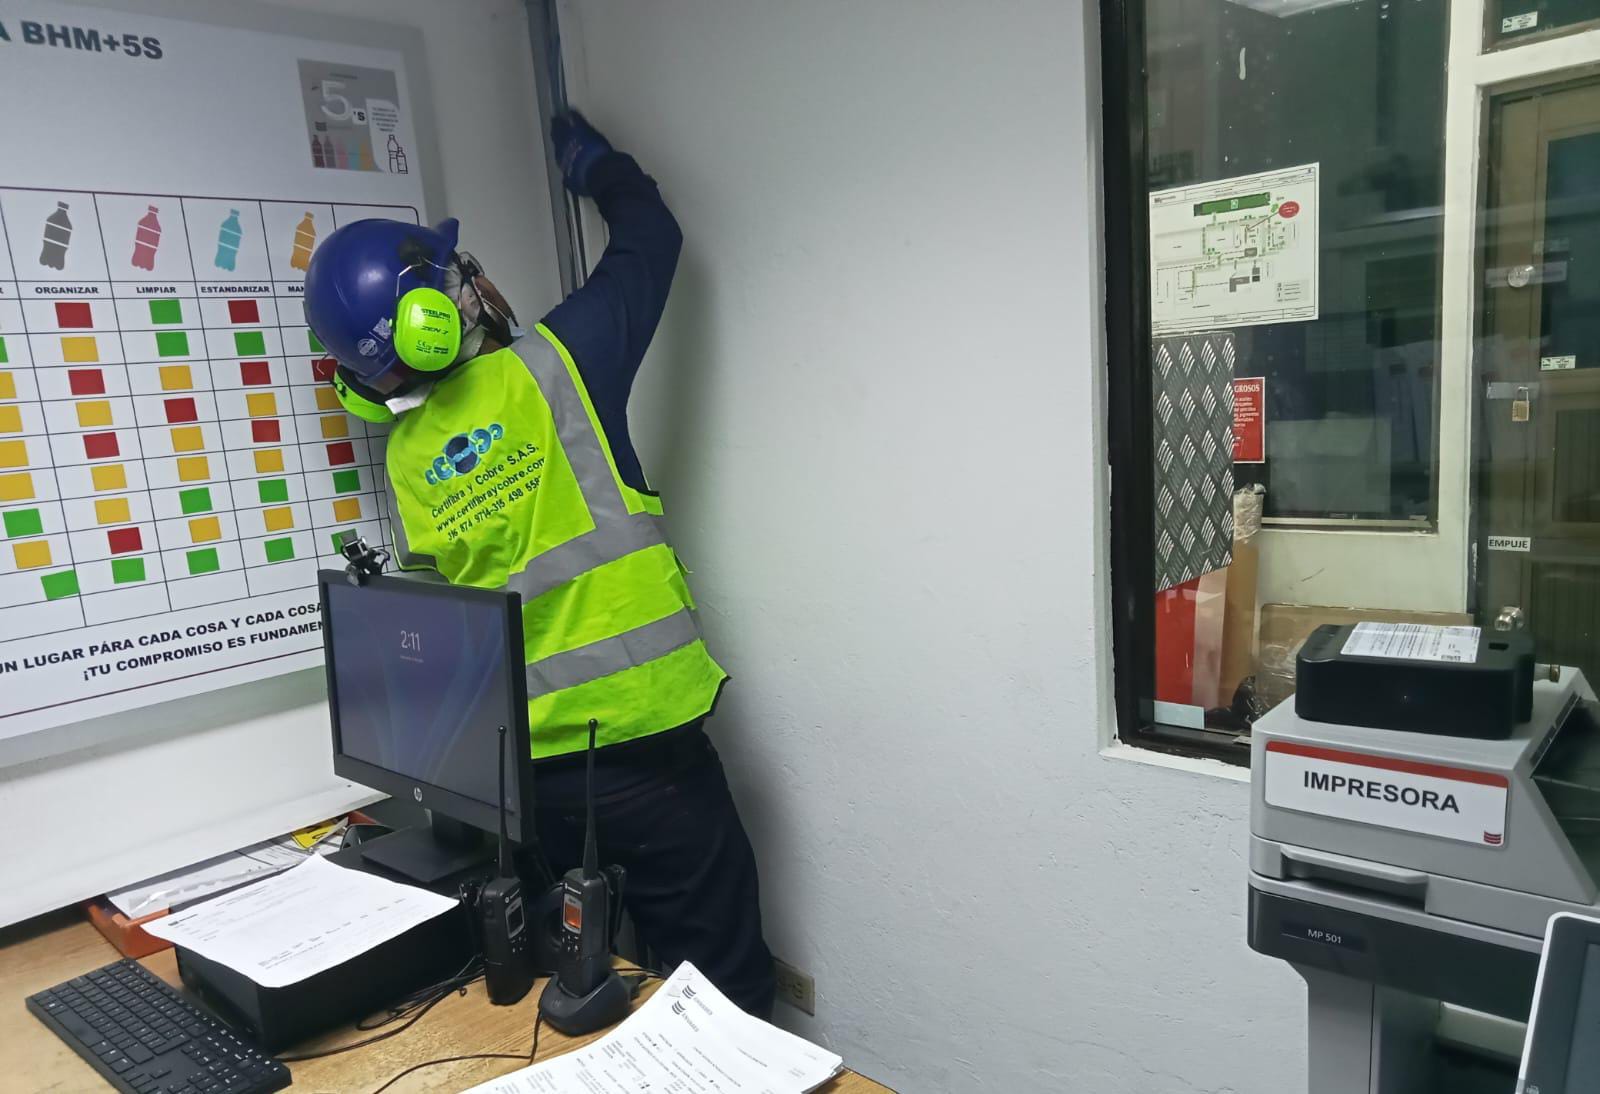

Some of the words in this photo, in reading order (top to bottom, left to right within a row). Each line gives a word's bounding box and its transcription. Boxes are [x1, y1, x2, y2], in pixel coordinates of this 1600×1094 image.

[20, 20, 163, 60] BHM+5S
[35, 286, 99, 294] ORGANIZAR
[136, 286, 177, 294] LIMPIAR
[431, 490, 466, 518] Certifibra
[466, 483, 473, 494] y
[475, 463, 505, 485] Cobre
[506, 443, 540, 465] S.A.S.
[508, 488, 524, 502] 498
[1489, 539, 1529, 548] EMPUJE
[23, 648, 85, 669] LUGAR
[89, 638, 134, 656] PÁRA
[138, 630, 182, 647] CADA
[186, 621, 228, 638] COSA
[230, 618, 241, 628] Y
[245, 610, 284, 625] CADA
[400, 630, 421, 652] 2:11
[83, 664, 111, 681] ¡TU
[116, 641, 223, 671] COMPROMISO
[228, 636, 246, 648] ES
[1303, 770, 1460, 814] IMPRESORA
[1307, 928, 1324, 939] MP
[1325, 933, 1342, 944] 501
